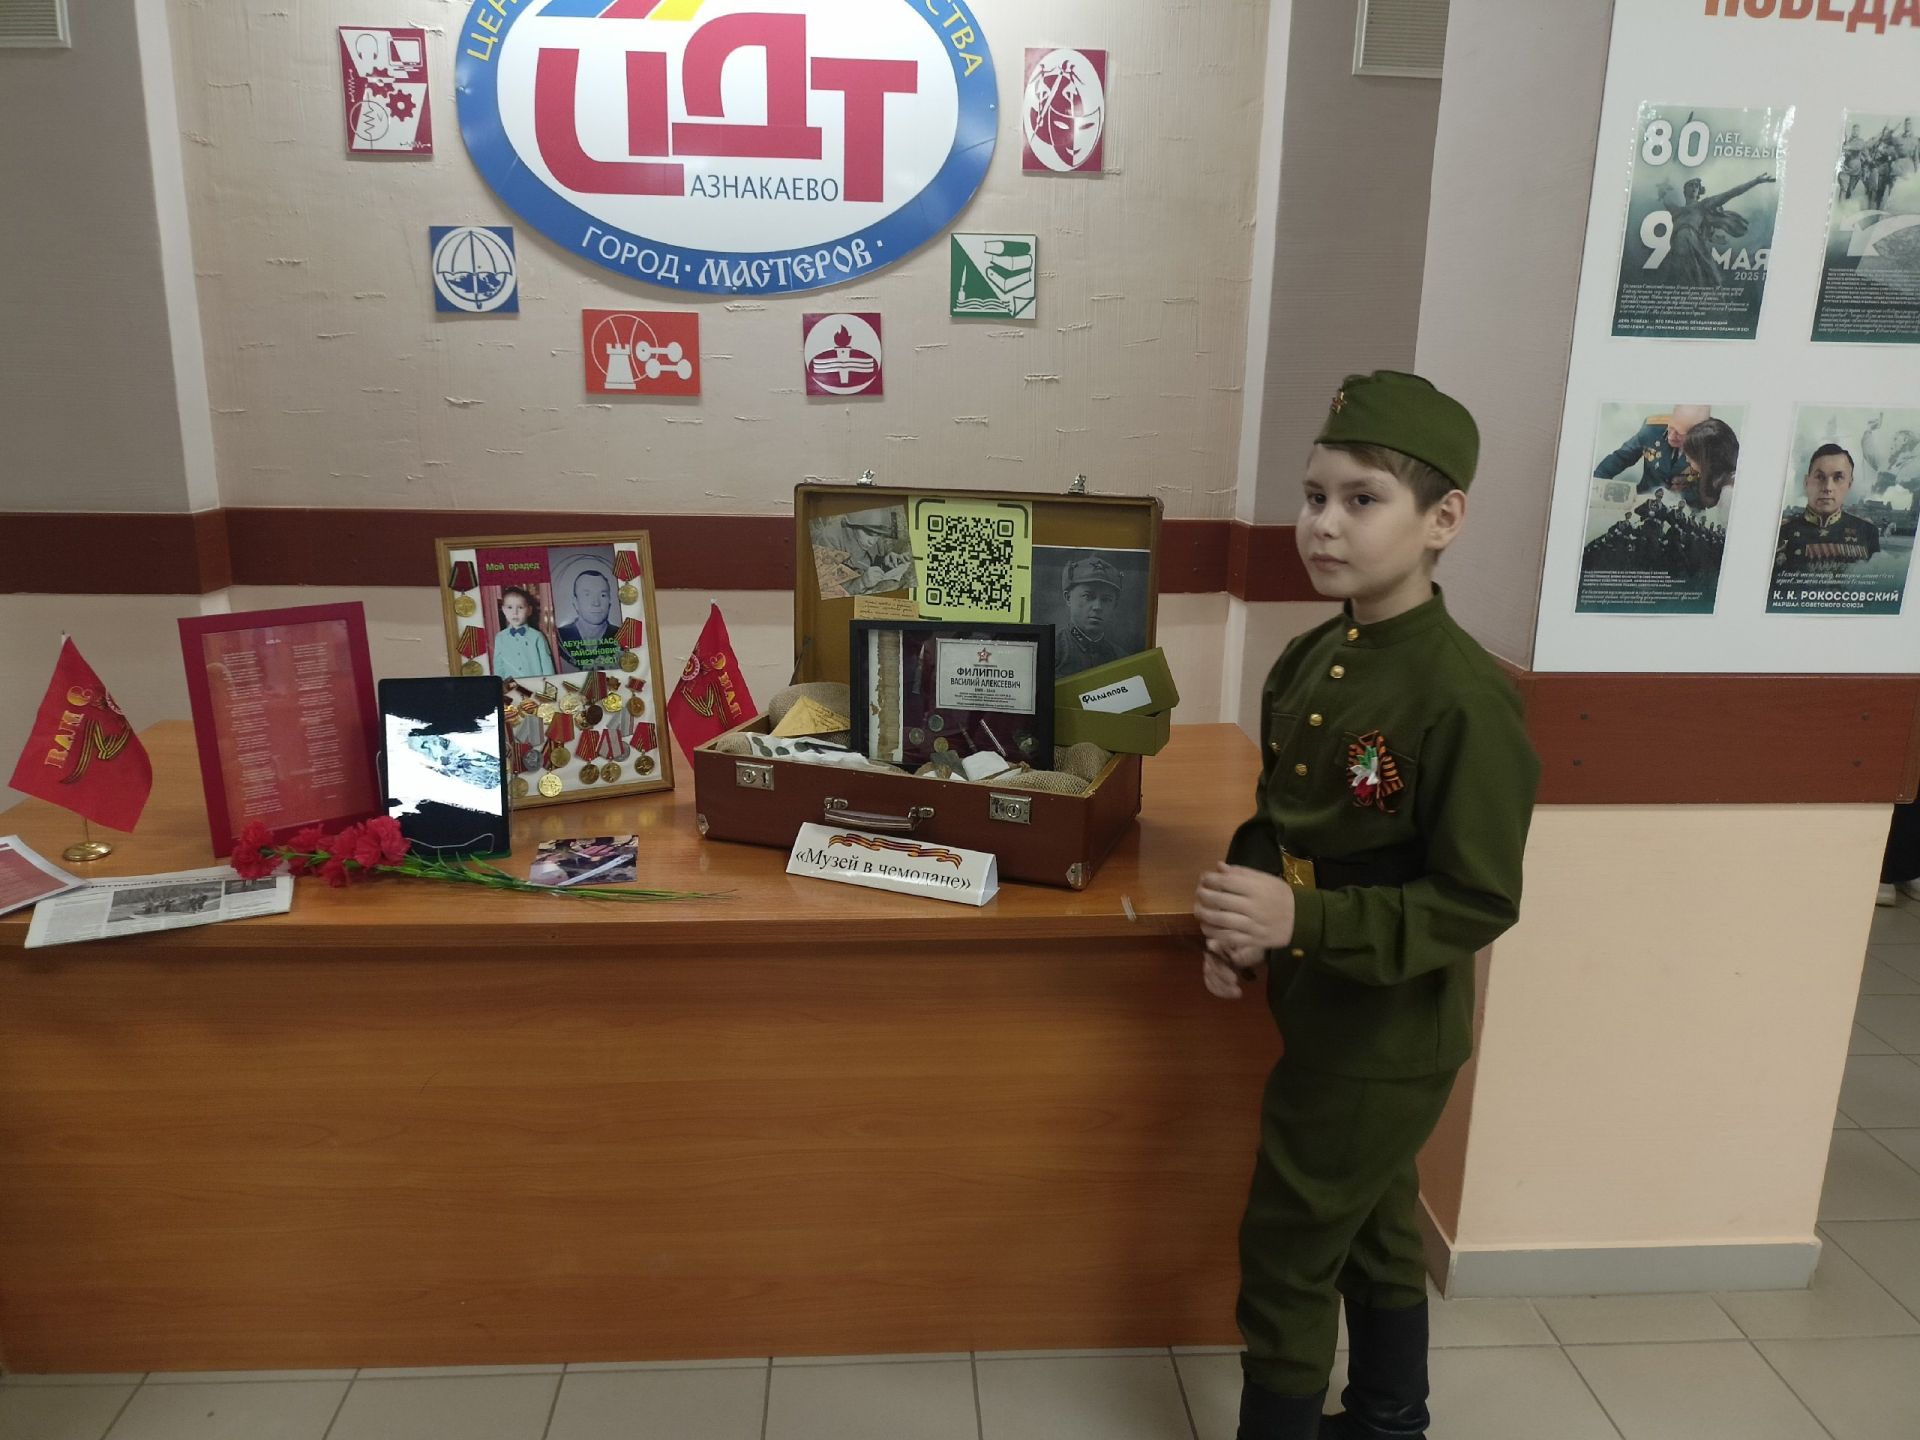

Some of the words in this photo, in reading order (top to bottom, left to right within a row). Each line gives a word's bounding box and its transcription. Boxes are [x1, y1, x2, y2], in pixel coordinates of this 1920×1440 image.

[534, 12, 918, 203] ЦДТ
[1640, 119, 1710, 167] 80
[690, 174, 839, 201] АЗНАКАЕВО
[582, 226, 680, 284] ГОРОД
[698, 237, 873, 288] МАСТЕРОВ
[1640, 211, 1674, 270] 9
[1711, 247, 1768, 271] МАЯ
[1734, 271, 1760, 281] 2025
[1801, 590, 1900, 602] РОКОССОВСКИЙ
[951, 678, 979, 687] ВАСИЛИЙ
[981, 679, 1020, 688] АЛЕКСЕЕВИЧ
[957, 667, 1014, 678] ФИЛИППОВ
[796, 848, 860, 871] «Музей
[863, 862, 873, 873] в
[879, 865, 971, 889] чемодане»
